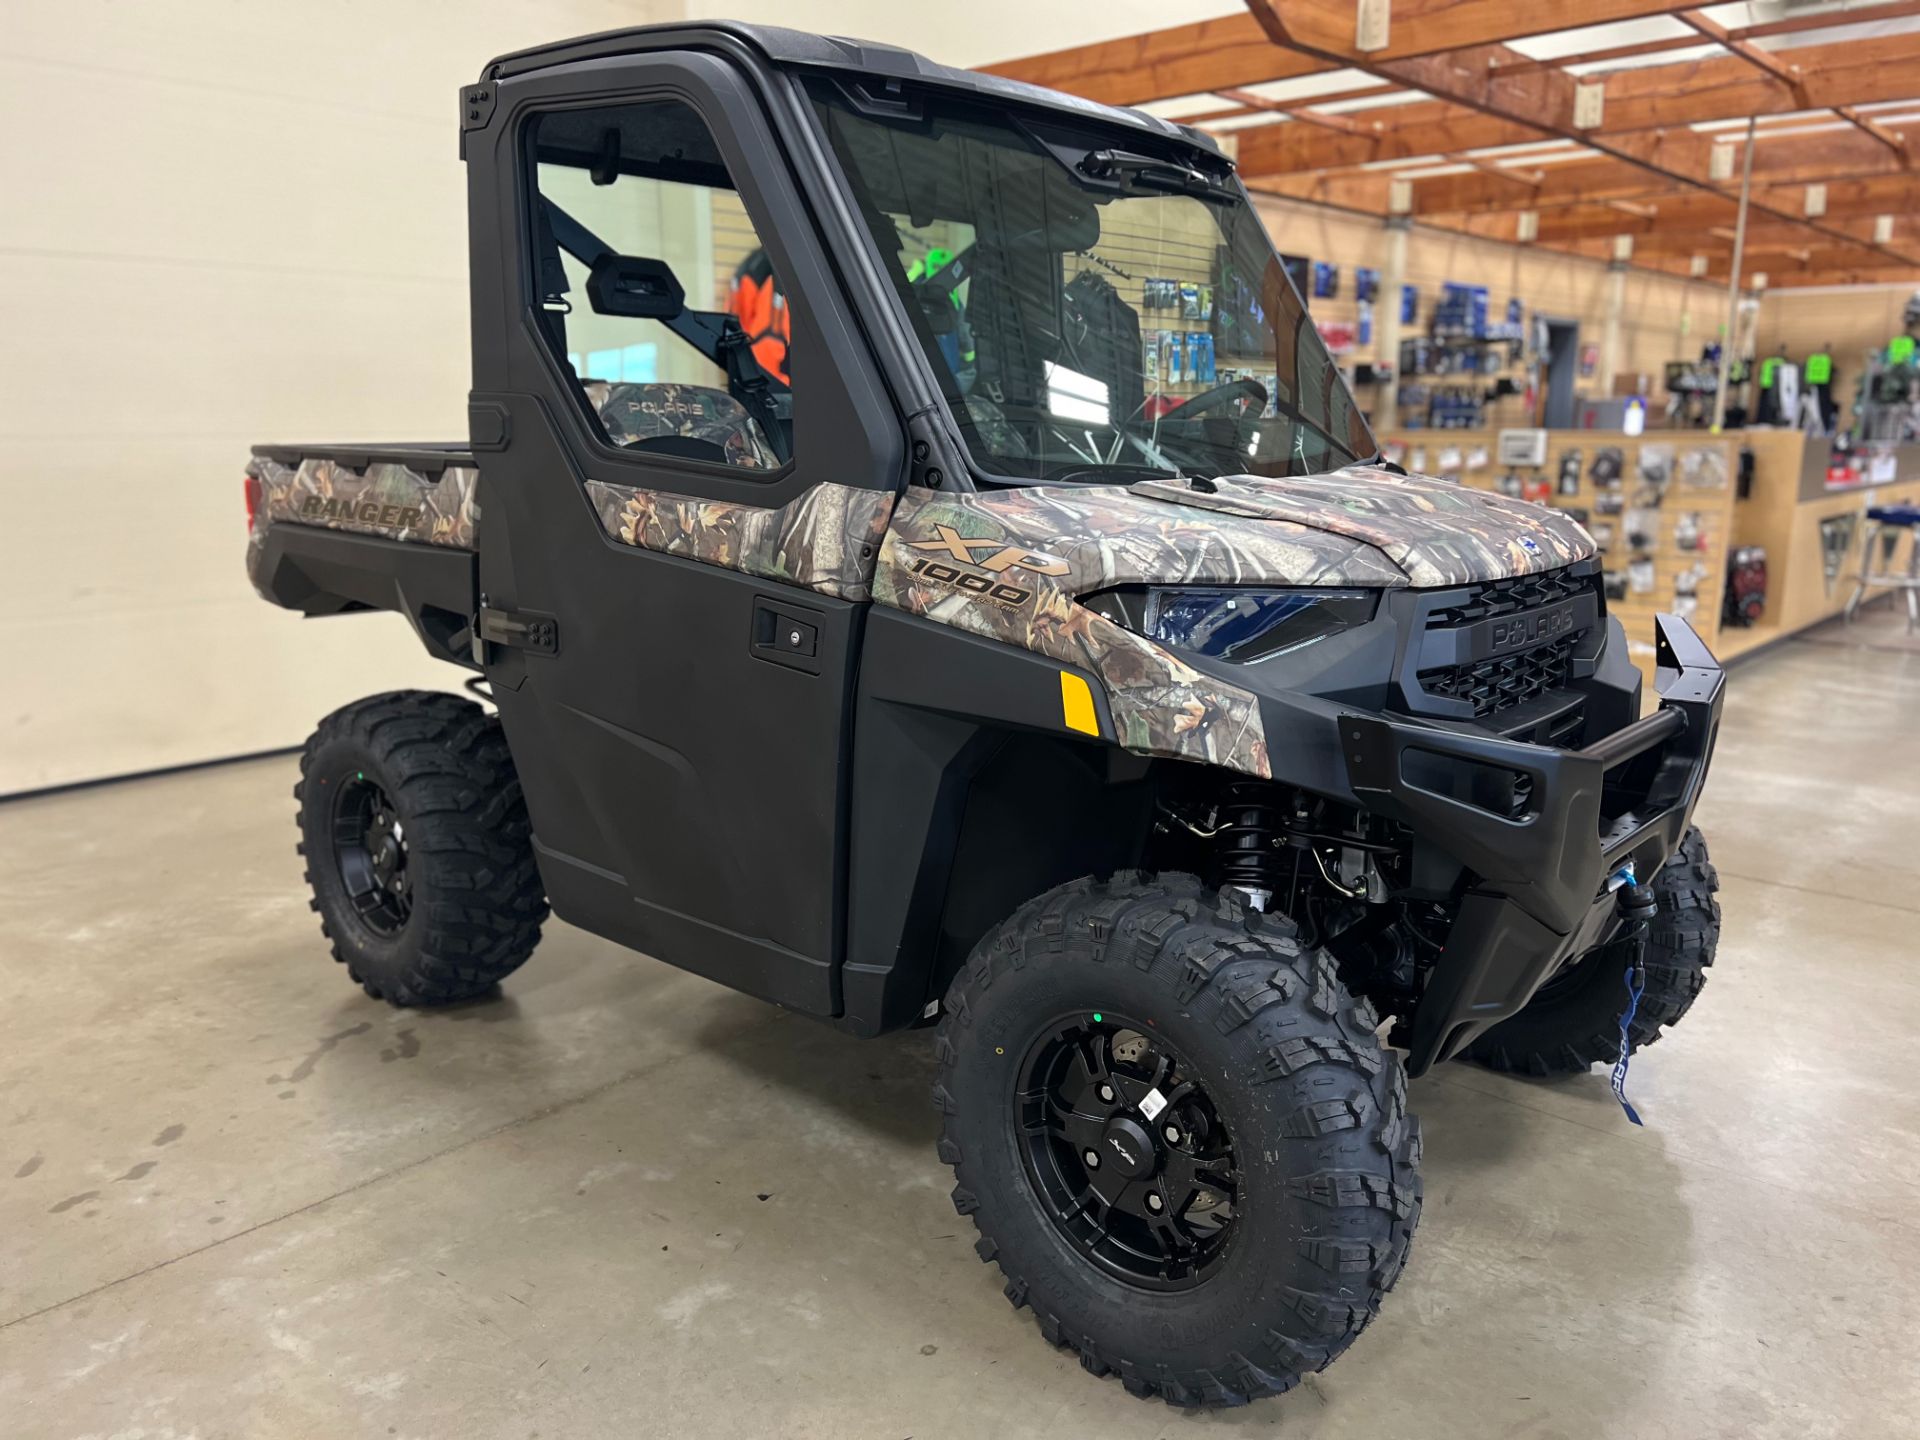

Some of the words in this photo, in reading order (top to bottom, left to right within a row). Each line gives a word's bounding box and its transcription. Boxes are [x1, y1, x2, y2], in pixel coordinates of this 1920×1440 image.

[628, 401, 704, 416] POLARIS
[302, 495, 421, 529] RANGER
[904, 522, 1072, 577] XP
[911, 557, 1033, 606] 1000
[1492, 606, 1574, 652] POLARIS
[1612, 1026, 1628, 1105] POLARIS
